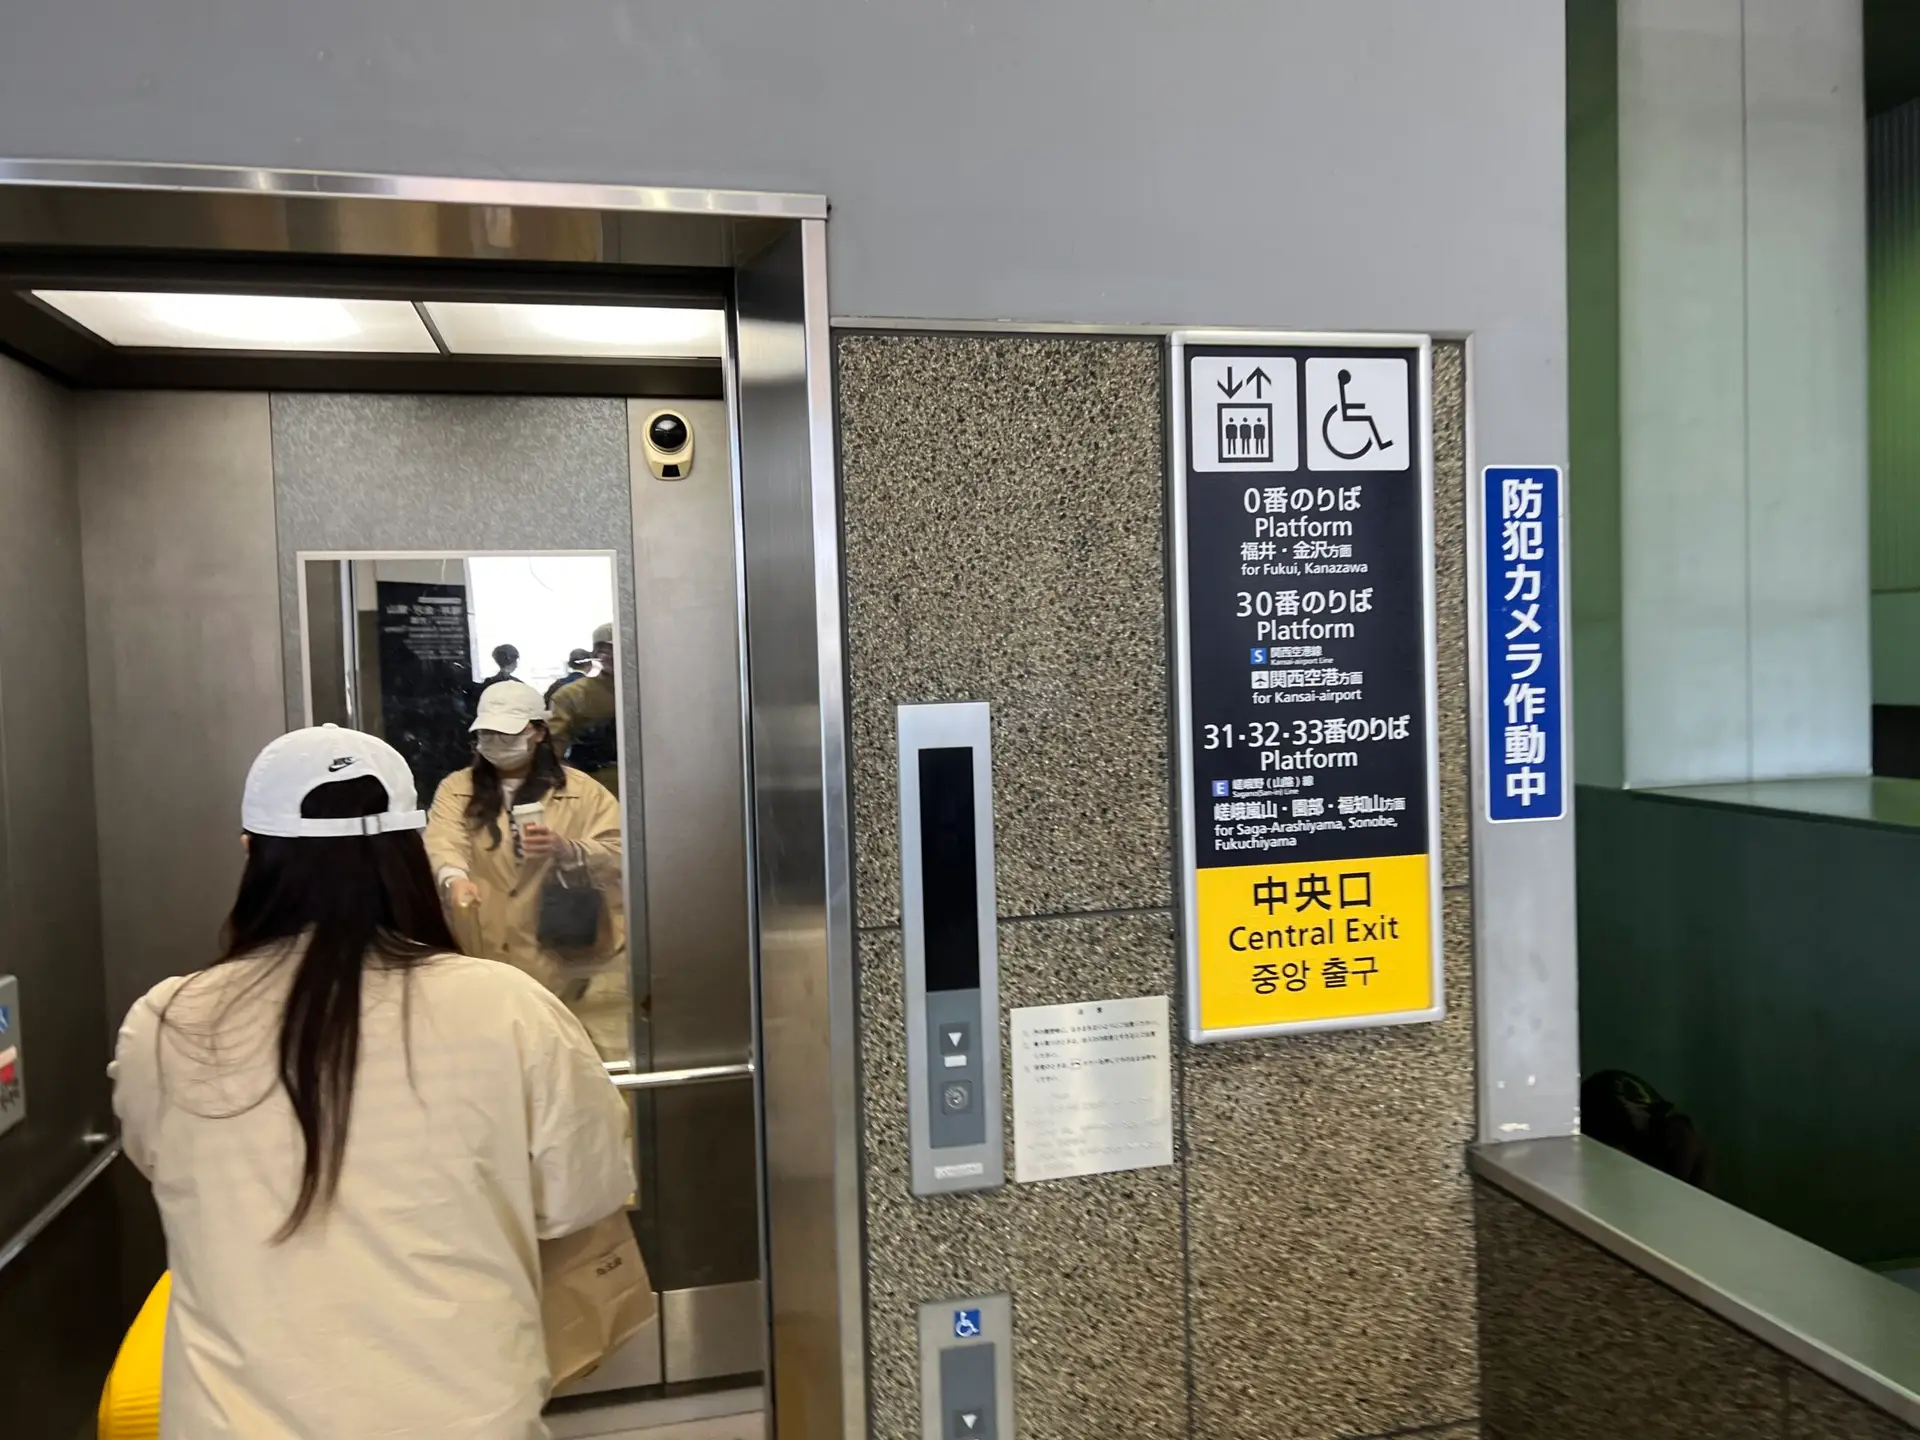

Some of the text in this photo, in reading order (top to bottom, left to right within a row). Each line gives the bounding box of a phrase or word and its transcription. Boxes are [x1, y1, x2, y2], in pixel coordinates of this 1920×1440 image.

[1243, 485, 1362, 513] 0番のりば
[1255, 515, 1352, 538] Platform
[1240, 541, 1352, 560] 福井・金沢方面
[1241, 562, 1368, 576] for Fukui, Kanazawa
[1236, 587, 1373, 617] 30番のりば
[1257, 618, 1355, 641] Platform
[1502, 478, 1546, 806] 防犯カメラ作動中
[1254, 650, 1263, 662] S
[1270, 668, 1363, 688] 関西空港方面
[1252, 689, 1362, 704] for Kansai-airport
[1261, 748, 1357, 771] Platform
[1217, 783, 1225, 794] E
[1214, 814, 1398, 837] for Saga-Arashiyama, Sonobe,
[1215, 837, 1297, 851] Fukuchiyama
[1253, 872, 1371, 915] 中央口
[1229, 915, 1399, 952] Central Exit
[1251, 956, 1379, 995] 중앙 출구
